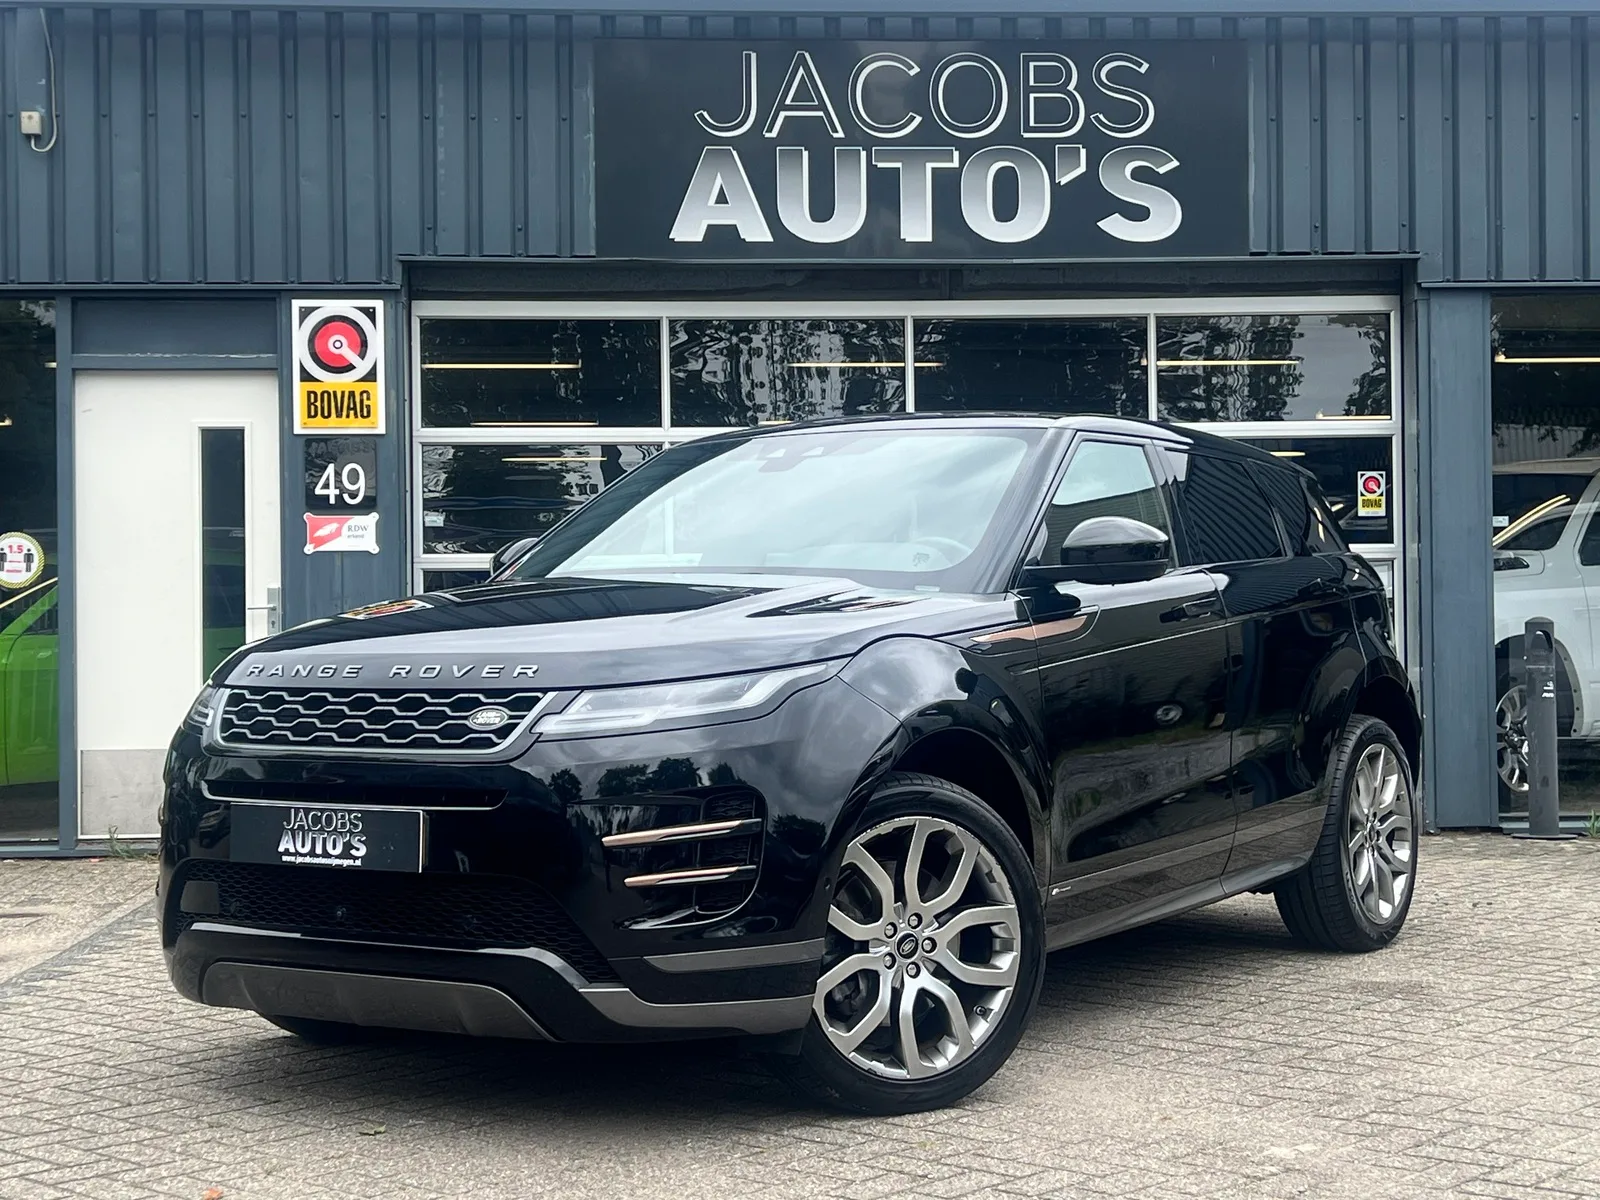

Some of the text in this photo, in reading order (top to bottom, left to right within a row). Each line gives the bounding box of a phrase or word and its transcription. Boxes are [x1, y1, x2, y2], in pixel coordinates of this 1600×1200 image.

[694, 50, 1156, 138] JACOBS
[669, 145, 1183, 242] AUTO'S
[306, 389, 372, 419] BOVAG
[314, 462, 366, 505] 49
[1361, 498, 1382, 508] BOVAG
[347, 524, 369, 532] RDW
[246, 664, 540, 679] RANGE ROVER
[283, 808, 363, 832] JACOBS
[278, 829, 367, 857] AUTO'S
